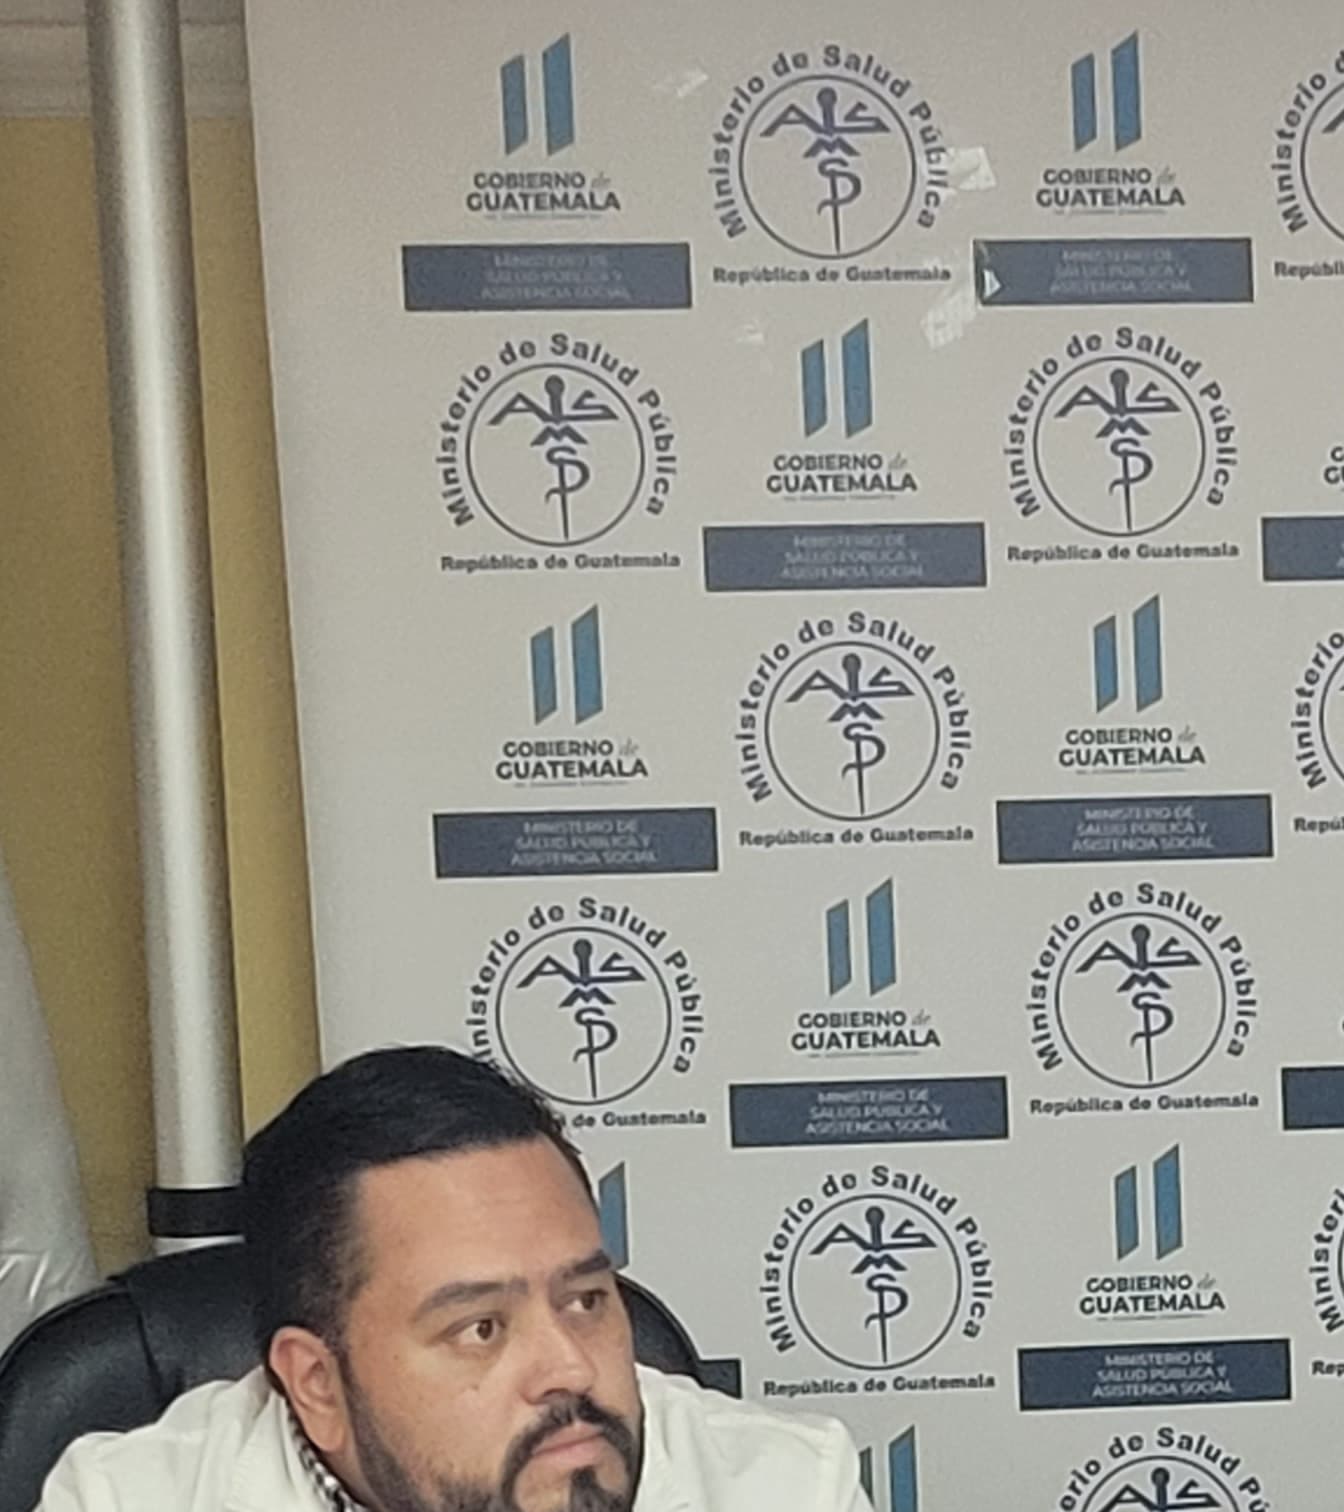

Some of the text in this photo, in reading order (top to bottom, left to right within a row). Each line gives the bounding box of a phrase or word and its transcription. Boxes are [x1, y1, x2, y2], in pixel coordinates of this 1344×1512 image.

[1271, 74, 1326, 233] Ministerio
[473, 171, 586, 189] GOBIERNO
[465, 192, 621, 211] GUATEMALA
[436, 333, 677, 526] Ministerio de Salud Pública
[441, 552, 680, 573] República de Guatemala
[735, 611, 971, 802] Ministerio de Salud Pública
[503, 739, 614, 758] GOBIERNO
[495, 758, 648, 780] GUATEMALA
[739, 826, 973, 848] República de Guatemala
[798, 1010, 907, 1029] GOBIERNO
[790, 1028, 941, 1051] GUATEMALA
[760, 1165, 993, 1353] Ministerio de Salud Pública
[1086, 1273, 1192, 1293] GOBIERNO
[1079, 1292, 1225, 1315] GUATEMALA
[764, 1374, 995, 1398] República de Guatemala
